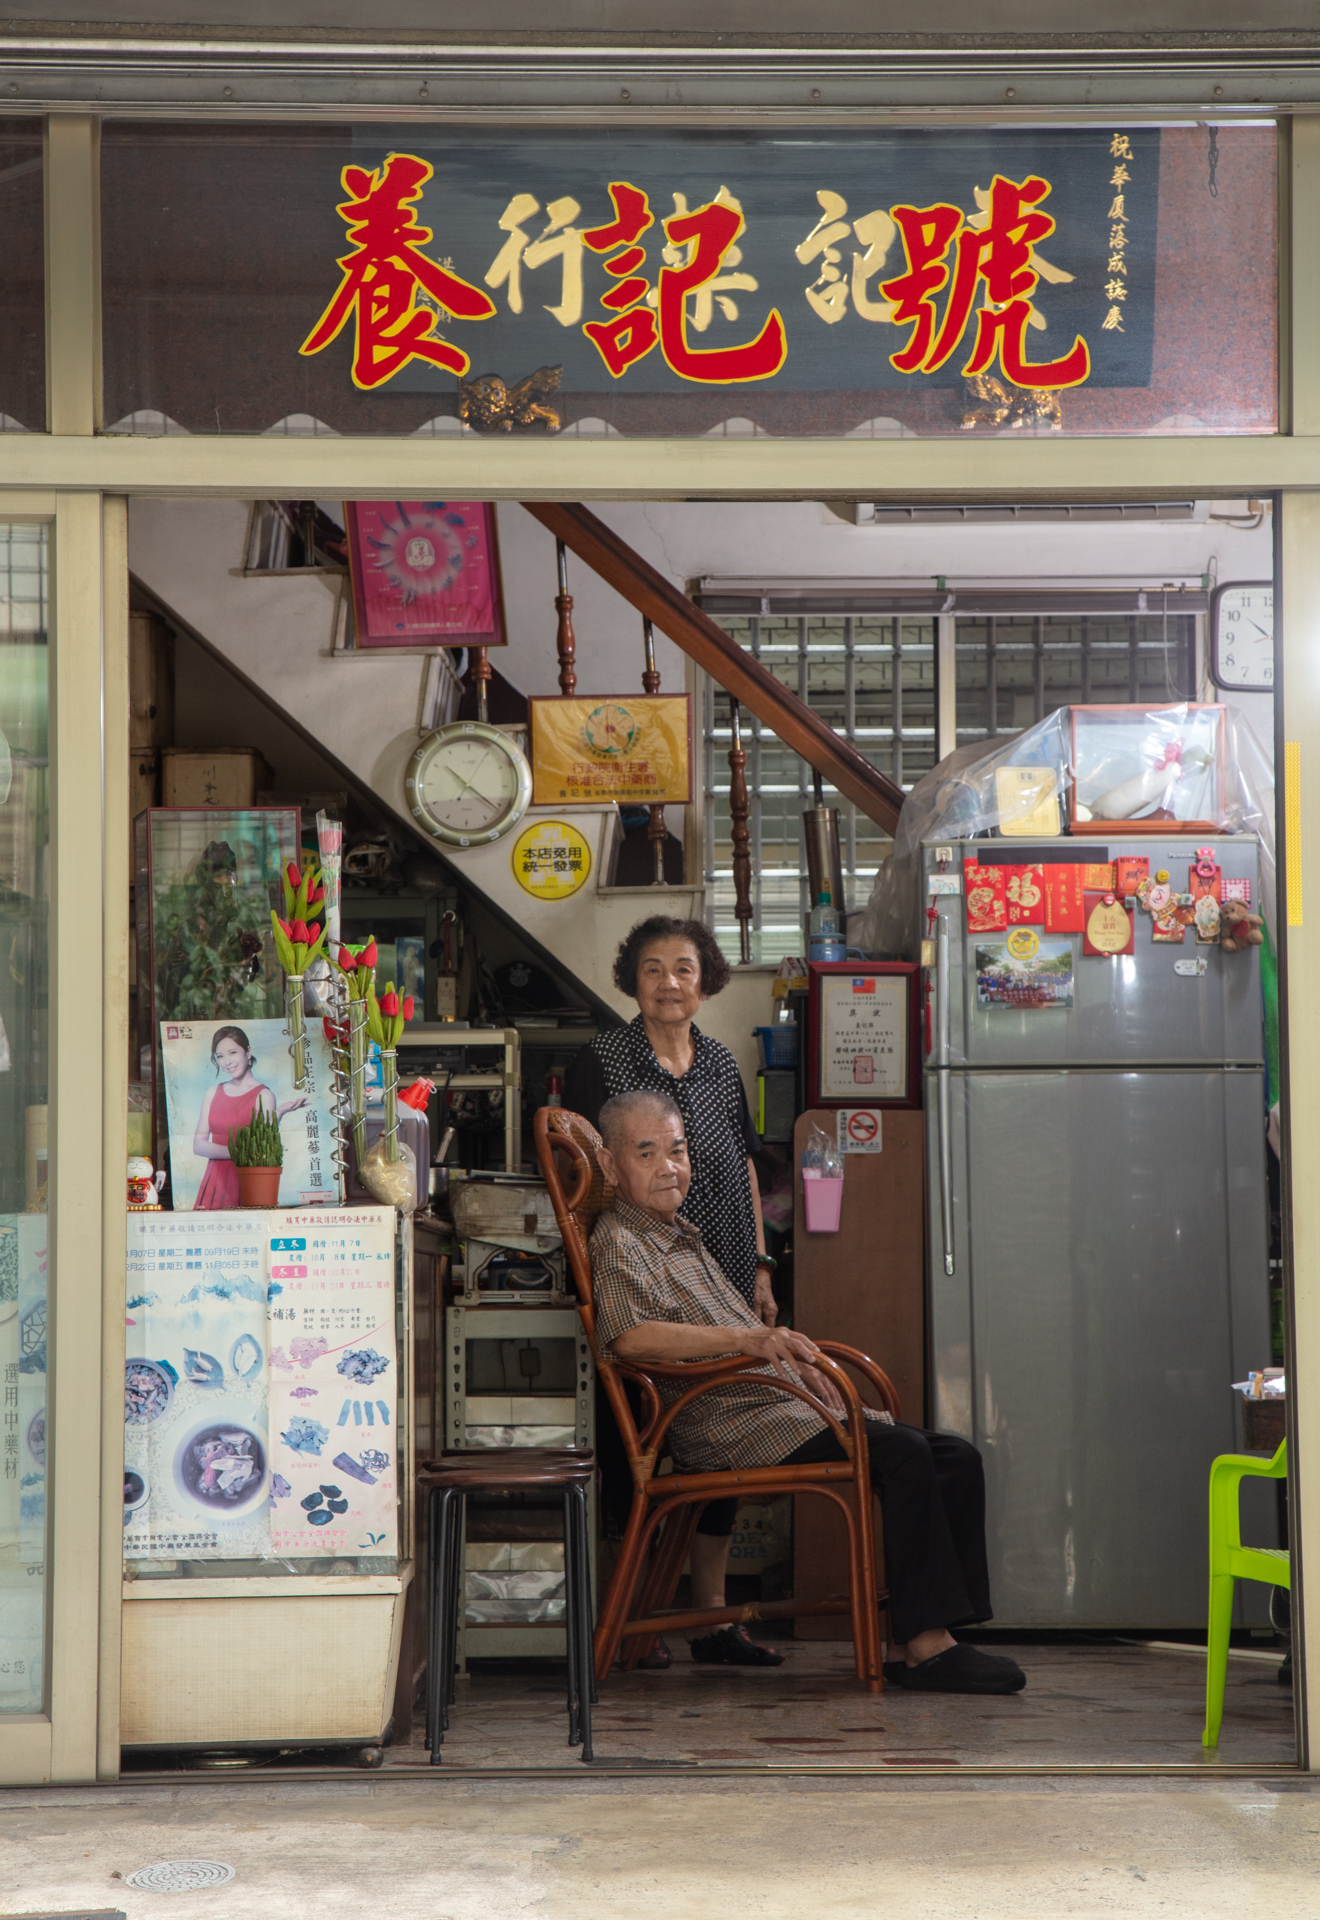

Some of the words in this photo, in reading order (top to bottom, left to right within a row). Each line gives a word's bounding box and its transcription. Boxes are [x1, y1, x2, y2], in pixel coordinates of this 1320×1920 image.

[1241, 596, 1251, 607] 11
[1228, 610, 1241, 622] 10
[1226, 632, 1235, 645] 9
[1225, 653, 1235, 666] 8
[1241, 666, 1249, 678] 7
[461, 724, 476, 734] 12
[435, 730, 446, 741] 11
[493, 733, 501, 742] 1
[414, 748, 425, 760] 10
[511, 754, 522, 764] 2
[572, 761, 649, 775] 行政院衛生署
[406, 778, 415, 788] 9
[566, 773, 657, 787] 核准合法中藥商
[412, 806, 422, 817] 8
[511, 810, 520, 821] 4
[432, 828, 442, 837] 7
[488, 828, 499, 840] 5
[460, 836, 470, 846] 6
[522, 847, 582, 860] 本店免用
[522, 860, 583, 873] 統一發票
[139, 1223, 262, 1233] 購買中藥敬請認明合法中藥店
[277, 1239, 300, 1249] 立冬
[158, 1248, 183, 1258] 星期二
[204, 1246, 240, 1256] 09月19日
[242, 1246, 259, 1256] 未時
[158, 1261, 183, 1271] 星期五
[205, 1260, 240, 1270] 11月05日
[242, 1260, 259, 1269] 子時
[4, 1362, 20, 1479] 選用中藥材
